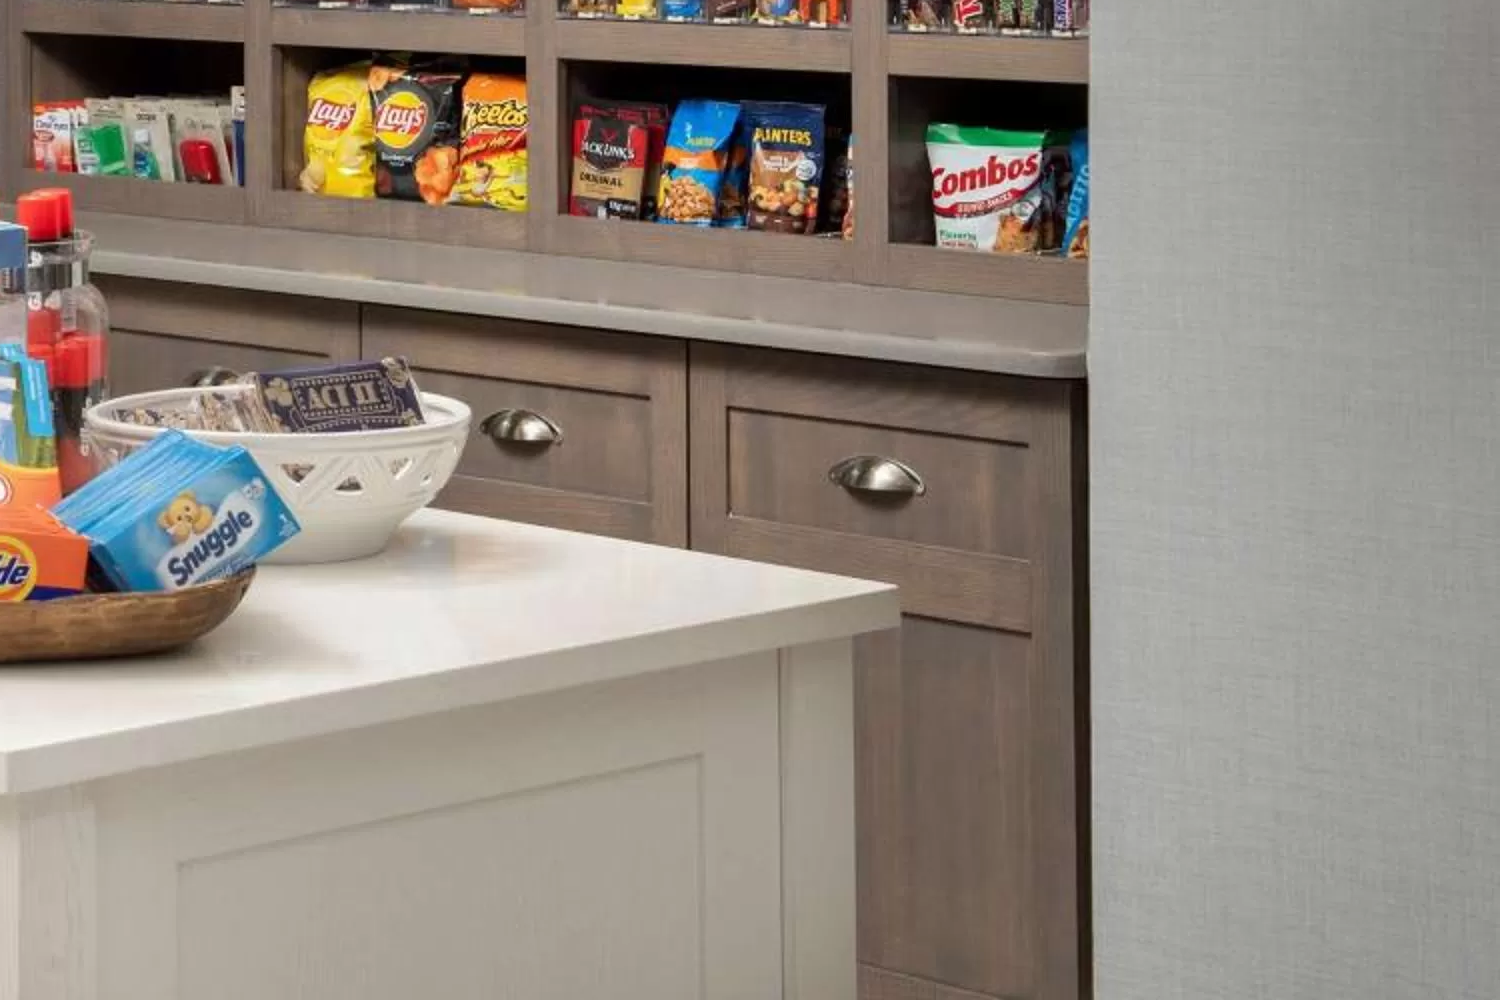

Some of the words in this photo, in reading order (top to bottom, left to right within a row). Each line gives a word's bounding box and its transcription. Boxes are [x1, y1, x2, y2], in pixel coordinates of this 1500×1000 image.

[308, 99, 356, 130] Lay's
[377, 103, 426, 134] Lay's
[931, 152, 1039, 200] Combos
[310, 383, 348, 409] ACT
[167, 510, 253, 587] Snuggle
